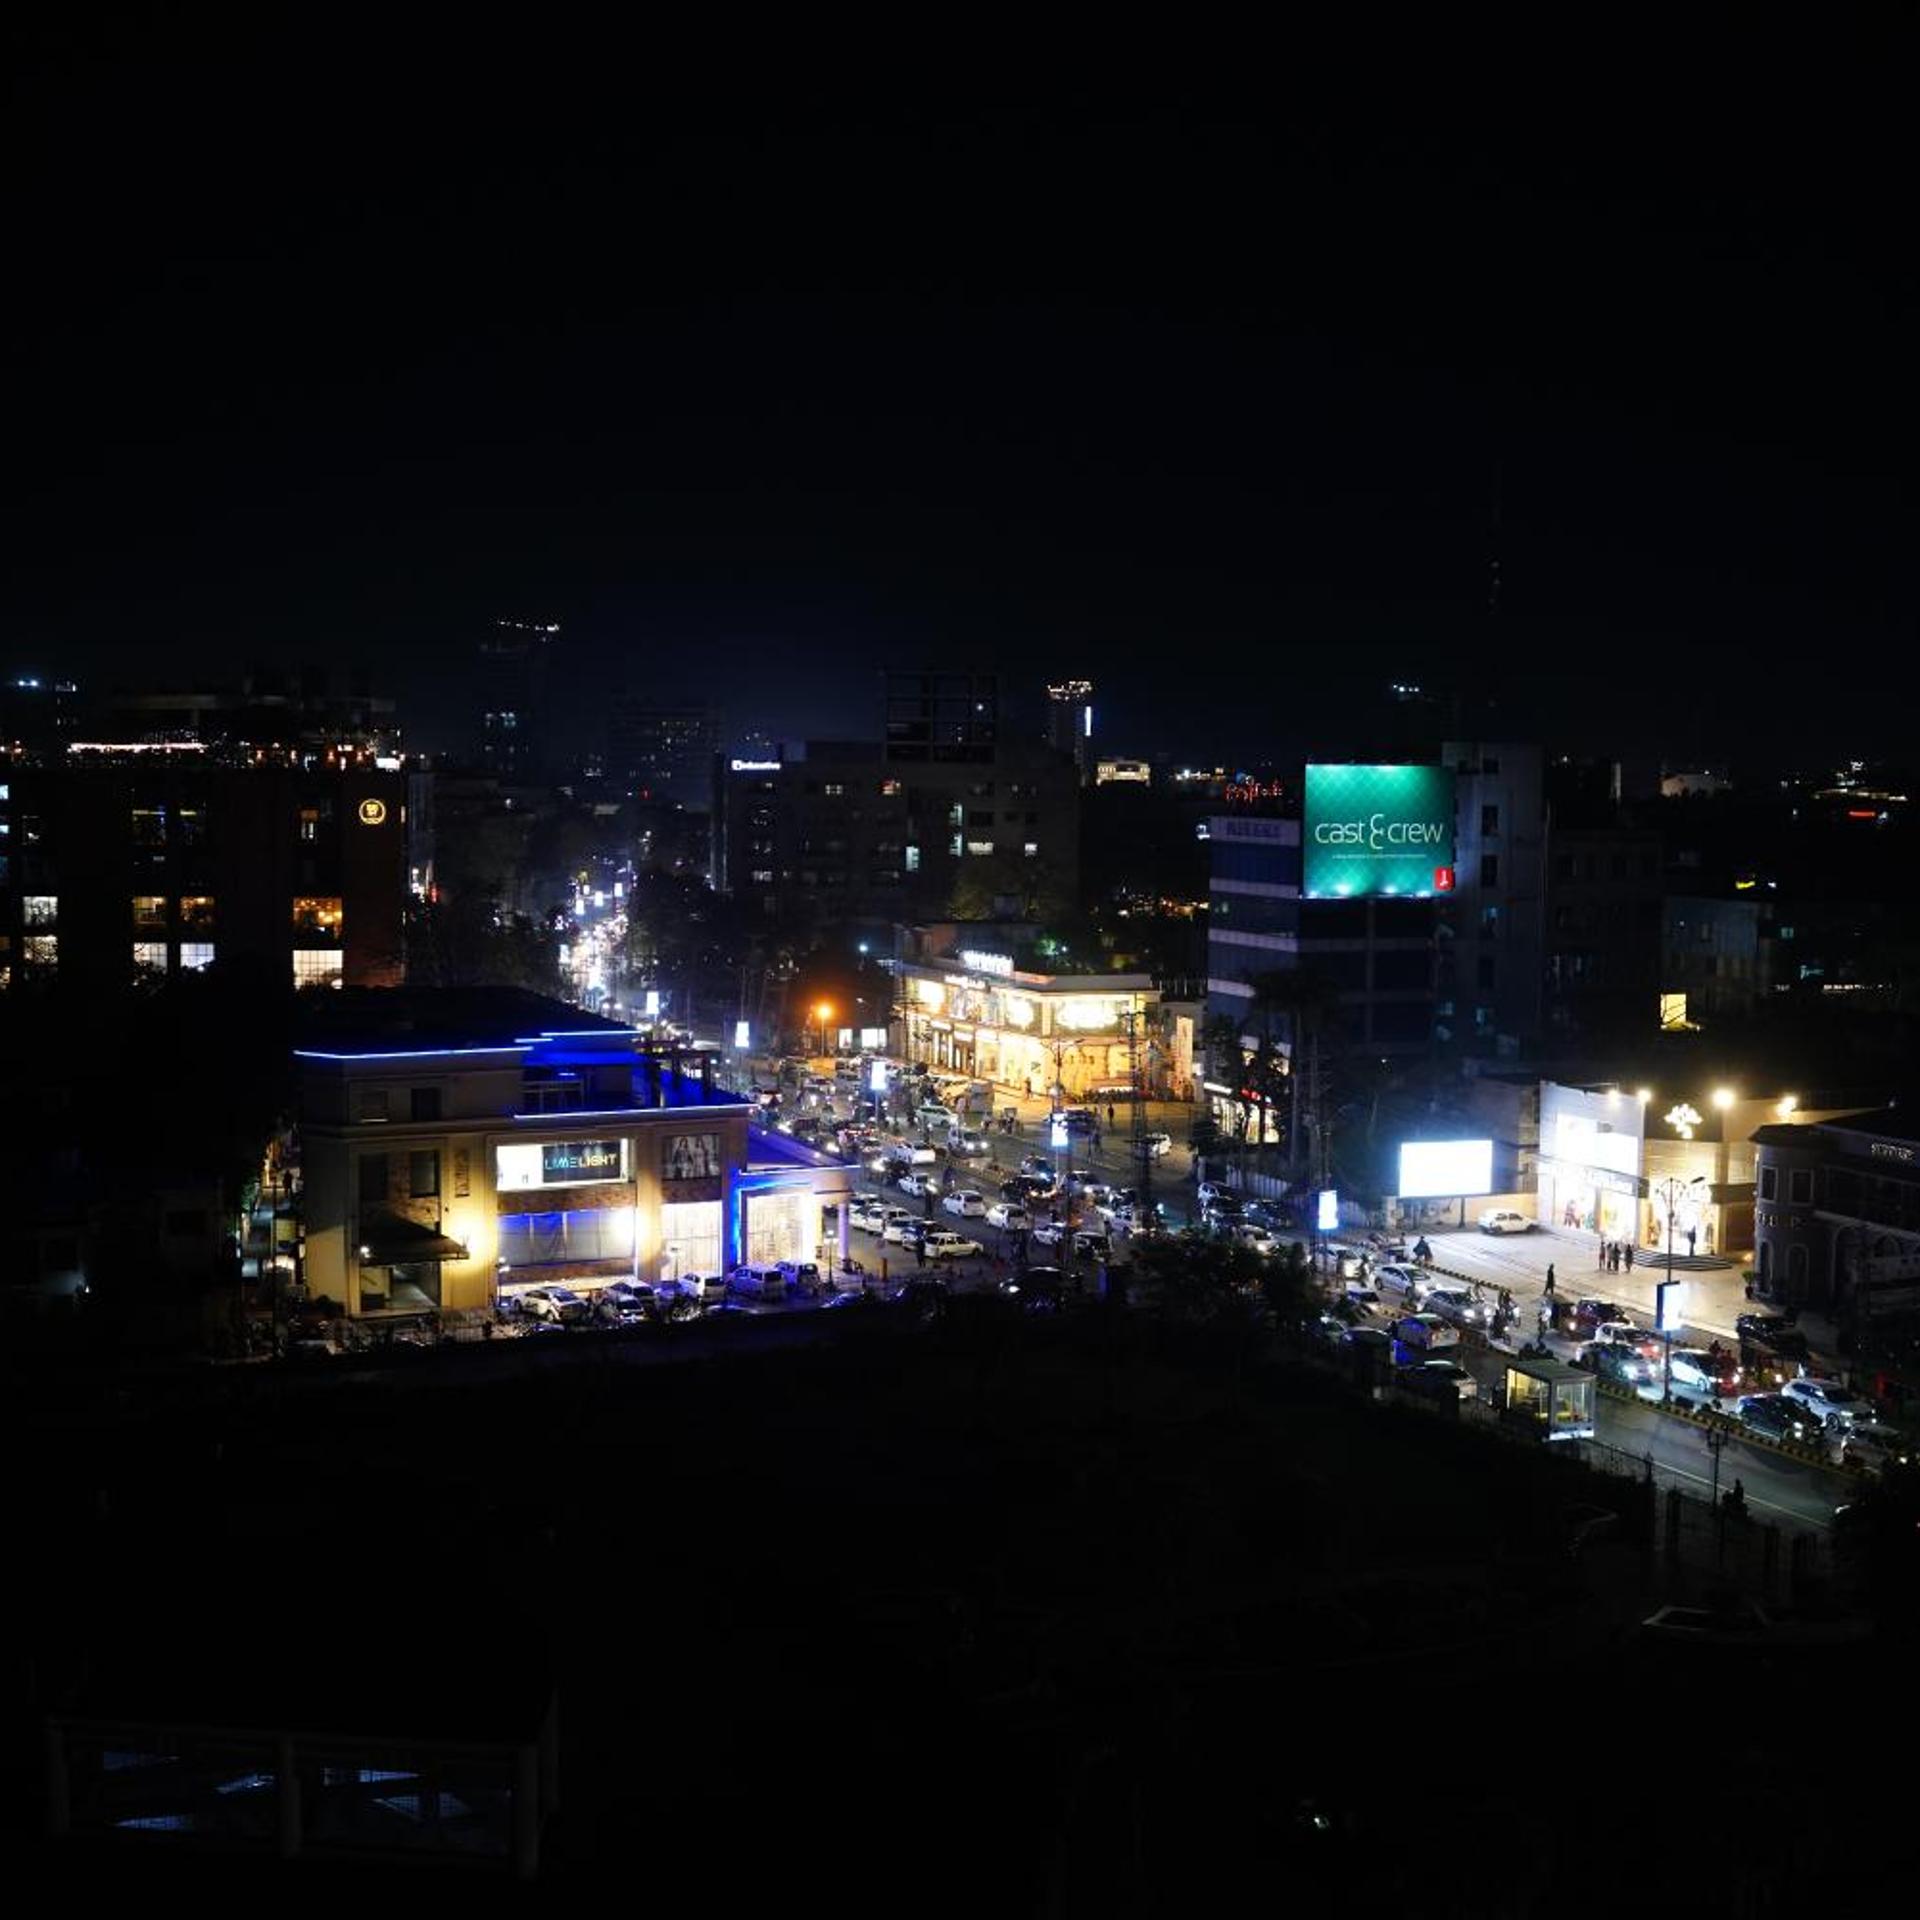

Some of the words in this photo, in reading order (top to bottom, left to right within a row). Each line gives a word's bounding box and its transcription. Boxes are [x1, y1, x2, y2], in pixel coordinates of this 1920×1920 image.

[1315, 821, 1365, 844] cast
[1387, 823, 1443, 843] crew
[544, 1153, 616, 1170] LIMELIGHT
